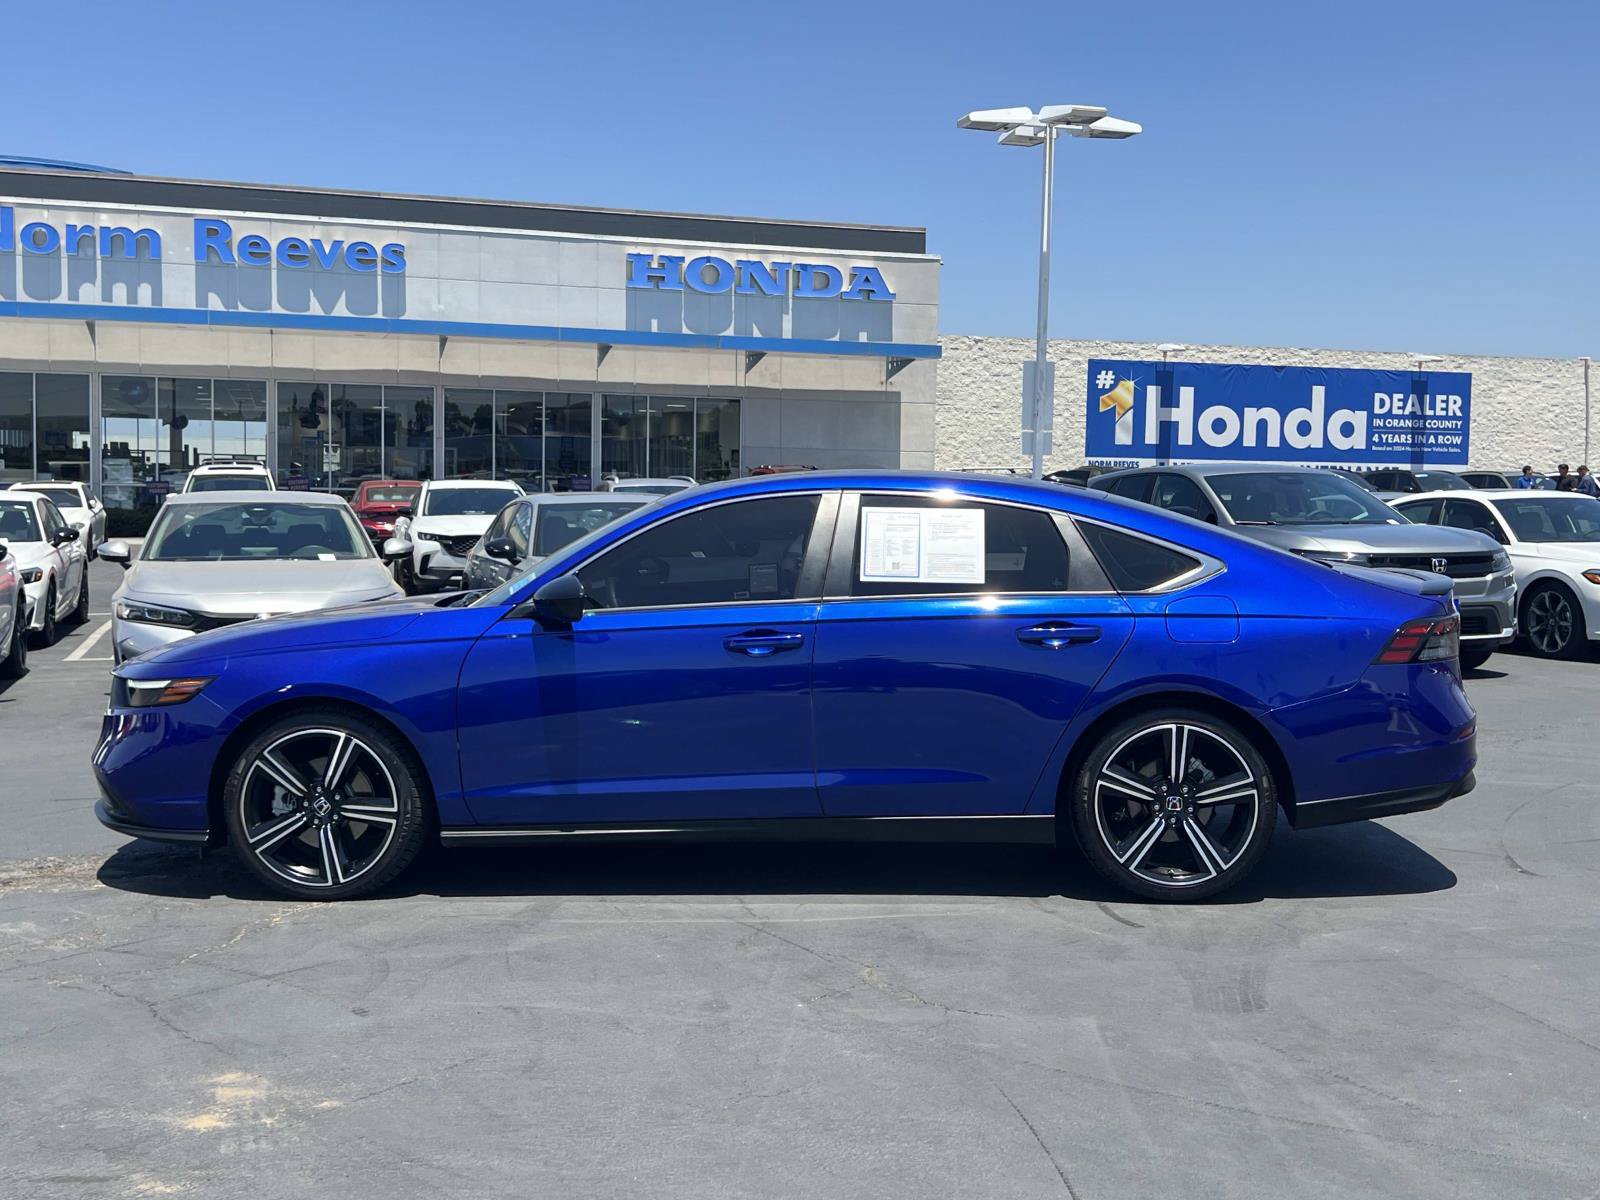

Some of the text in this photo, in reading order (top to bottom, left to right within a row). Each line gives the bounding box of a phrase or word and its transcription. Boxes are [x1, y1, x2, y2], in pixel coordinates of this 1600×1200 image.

[194, 218, 407, 273] Reeves
[626, 253, 896, 300] HONDA
[1144, 385, 1368, 450] Honda
[1374, 392, 1462, 416] DEALER
[1372, 433, 1462, 445] 4 YEARS IN A ROW
[1373, 418, 1462, 429] IN ORANGE COUNTY
